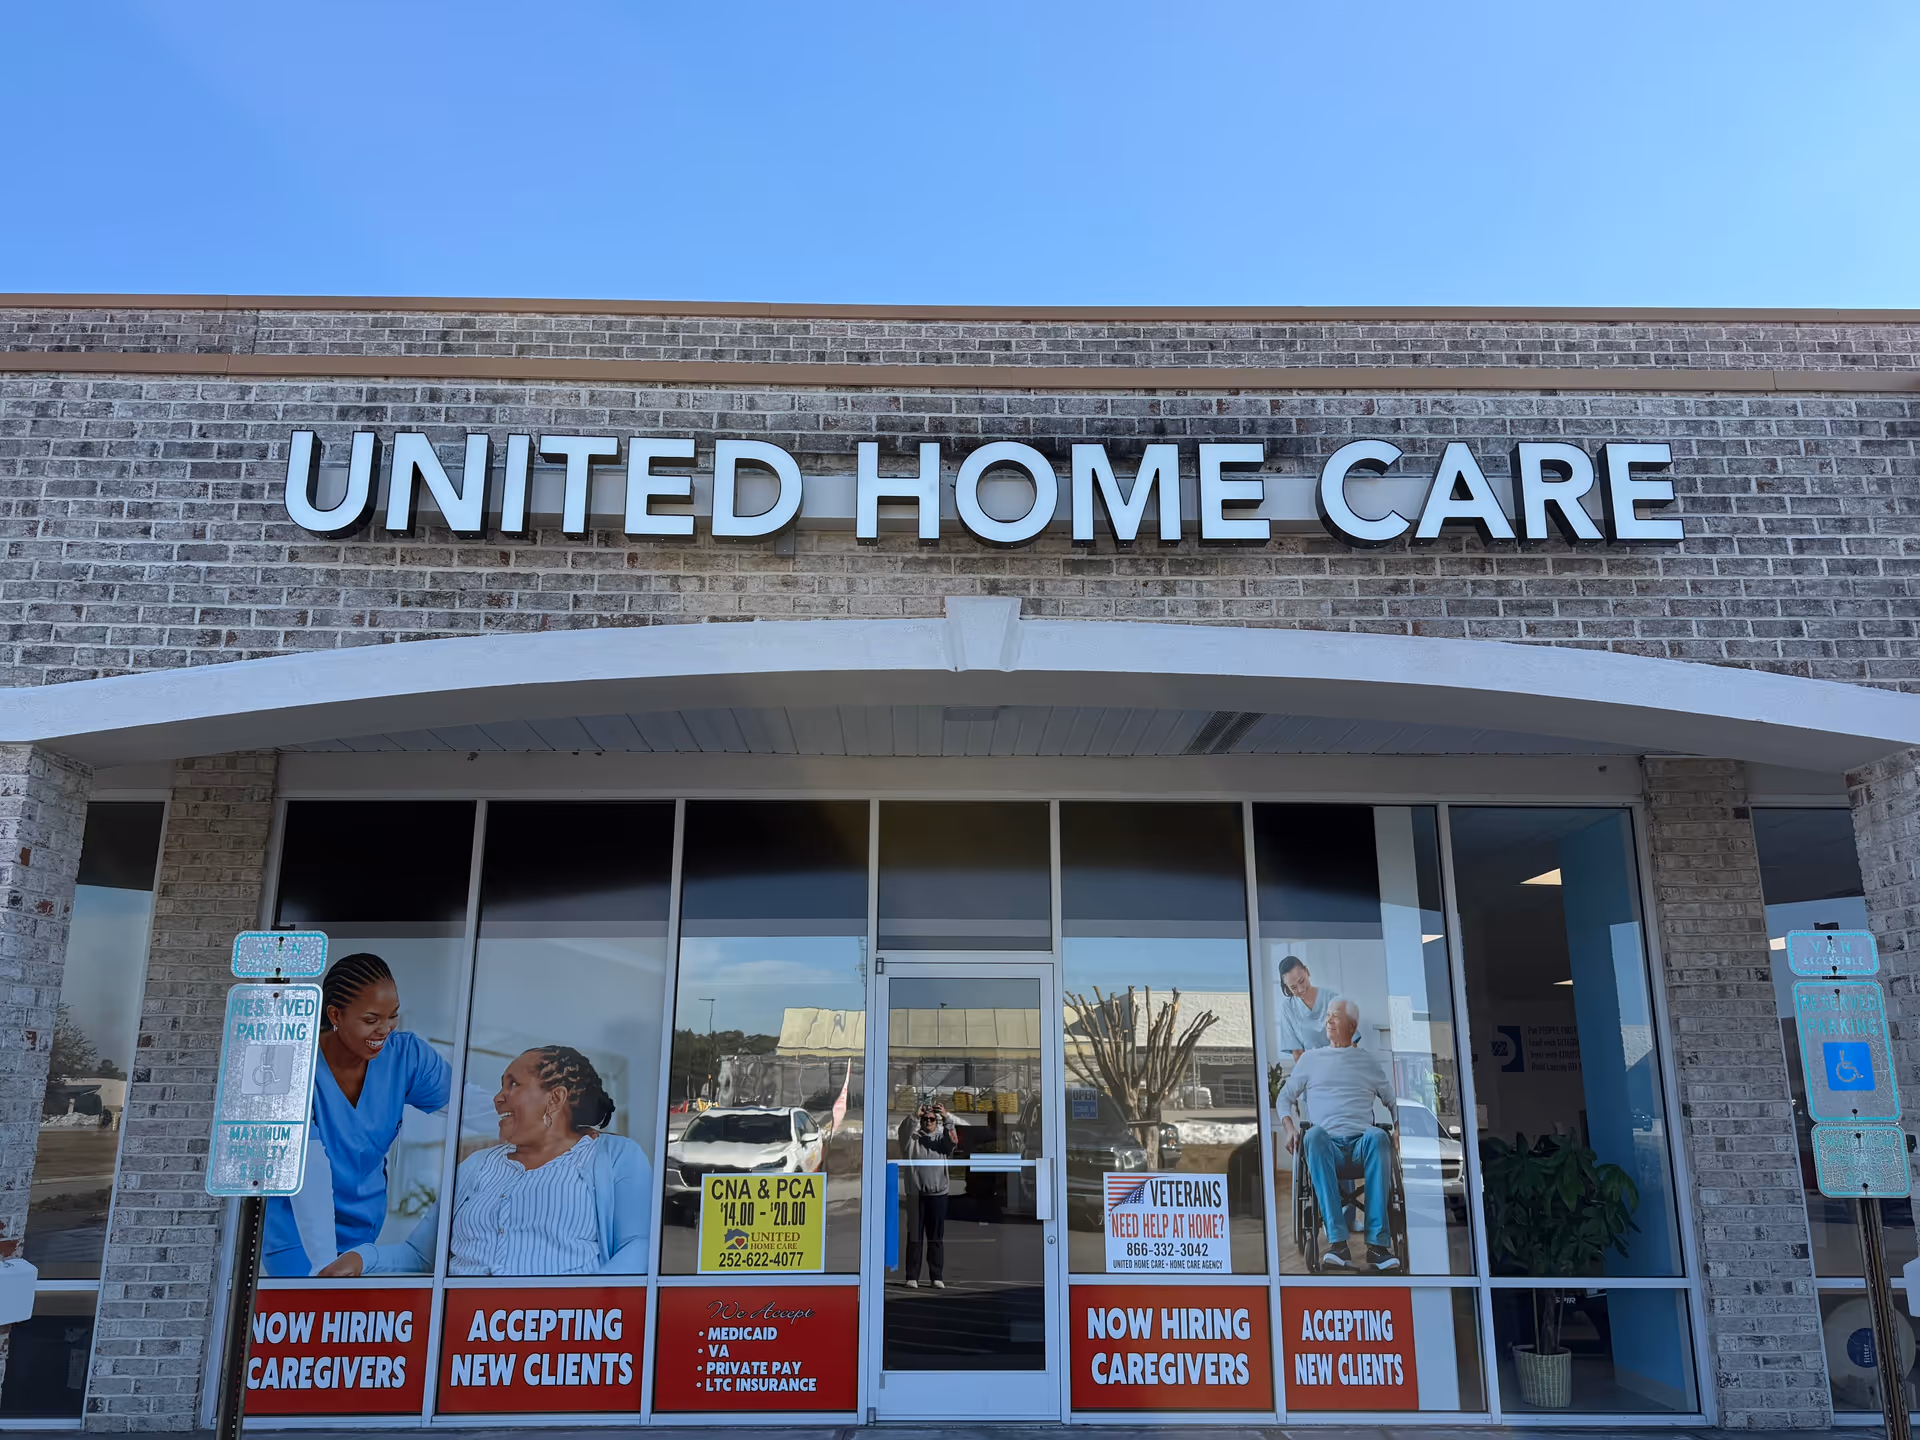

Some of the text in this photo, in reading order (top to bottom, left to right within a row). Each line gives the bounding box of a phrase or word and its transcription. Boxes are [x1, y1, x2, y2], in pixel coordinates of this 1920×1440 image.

[284, 430, 1685, 548] UNITED HOME CARE
[1810, 939, 1852, 953] VAN
[1799, 994, 1878, 1012] RESERVED
[235, 1023, 307, 1041] PARKING
[1806, 1018, 1879, 1036] PARKING
[1072, 1089, 1096, 1101] OPEN
[229, 1126, 291, 1141] MAXIMUM
[228, 1145, 288, 1160] PENALTY
[711, 1178, 816, 1200] CNA & PCA
[1150, 1180, 1222, 1208] VETERANS
[720, 1202, 755, 1226] $14.00
[770, 1201, 806, 1226] $20.00
[1111, 1213, 1225, 1239] NEED HELP AT HOME?
[750, 1231, 801, 1242] UNITED
[750, 1242, 798, 1250] HOME CARE
[1126, 1242, 1209, 1257] 866-332-3042
[718, 1252, 804, 1268] 252-622-4077
[1113, 1259, 1223, 1270] UNITED HOME CARE HOME CARE AGENCY
[707, 1300, 816, 1325] We Accept
[251, 1310, 413, 1344] NOW HIRING
[466, 1308, 623, 1342] ACCEPTING
[1086, 1307, 1251, 1340] NOW HIRING
[1301, 1309, 1394, 1342] ACCEPTING
[707, 1326, 778, 1341] MEDICAID
[708, 1344, 730, 1358] VA
[246, 1356, 406, 1390] CAREGIVERS
[450, 1352, 633, 1387] NEW CLIENTS
[706, 1361, 802, 1375] PRIVATE PAY
[1091, 1352, 1250, 1386] CAREGIVERS
[1294, 1353, 1404, 1386] NEW CLIENTS
[705, 1378, 817, 1392] LTC INSURANCE
